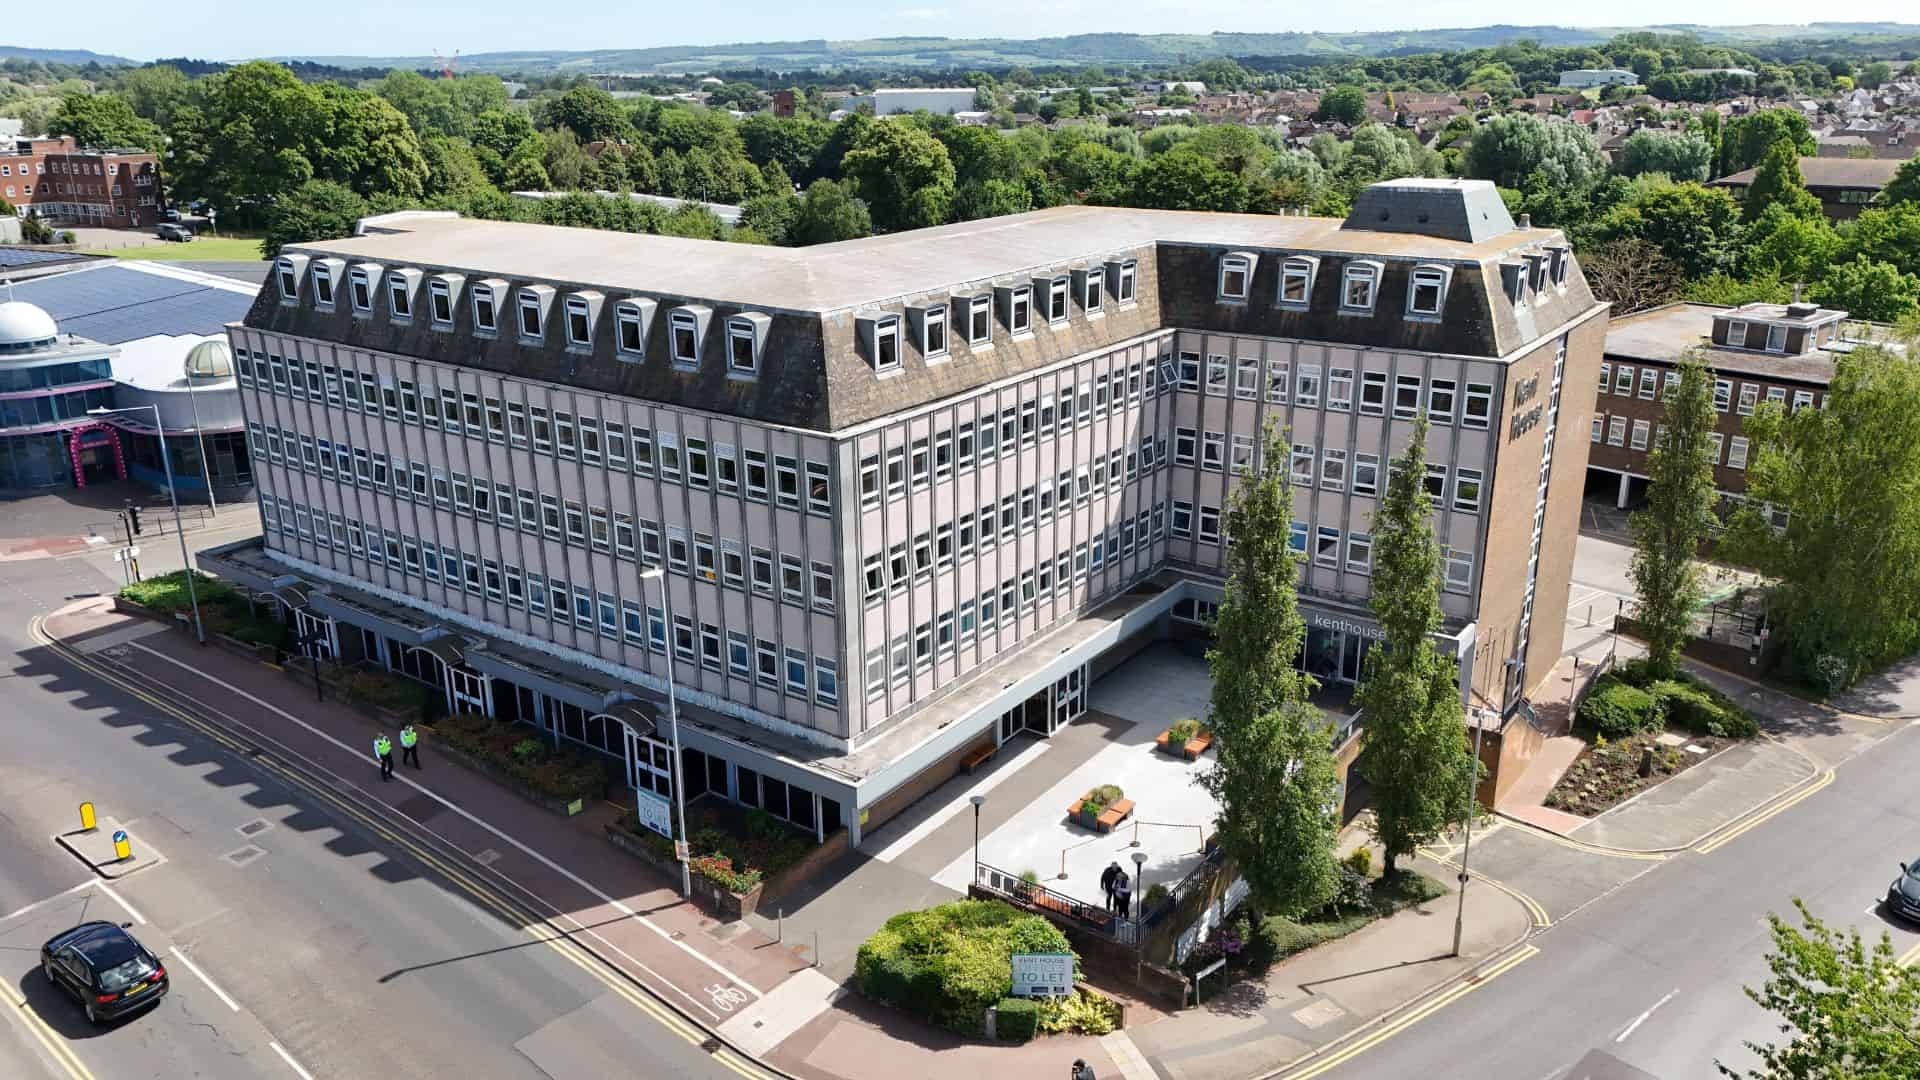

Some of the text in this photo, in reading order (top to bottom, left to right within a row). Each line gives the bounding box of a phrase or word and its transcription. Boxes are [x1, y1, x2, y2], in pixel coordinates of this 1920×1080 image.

[1315, 612, 1385, 640] kenthouse
[1021, 972, 1065, 982] TO LET
